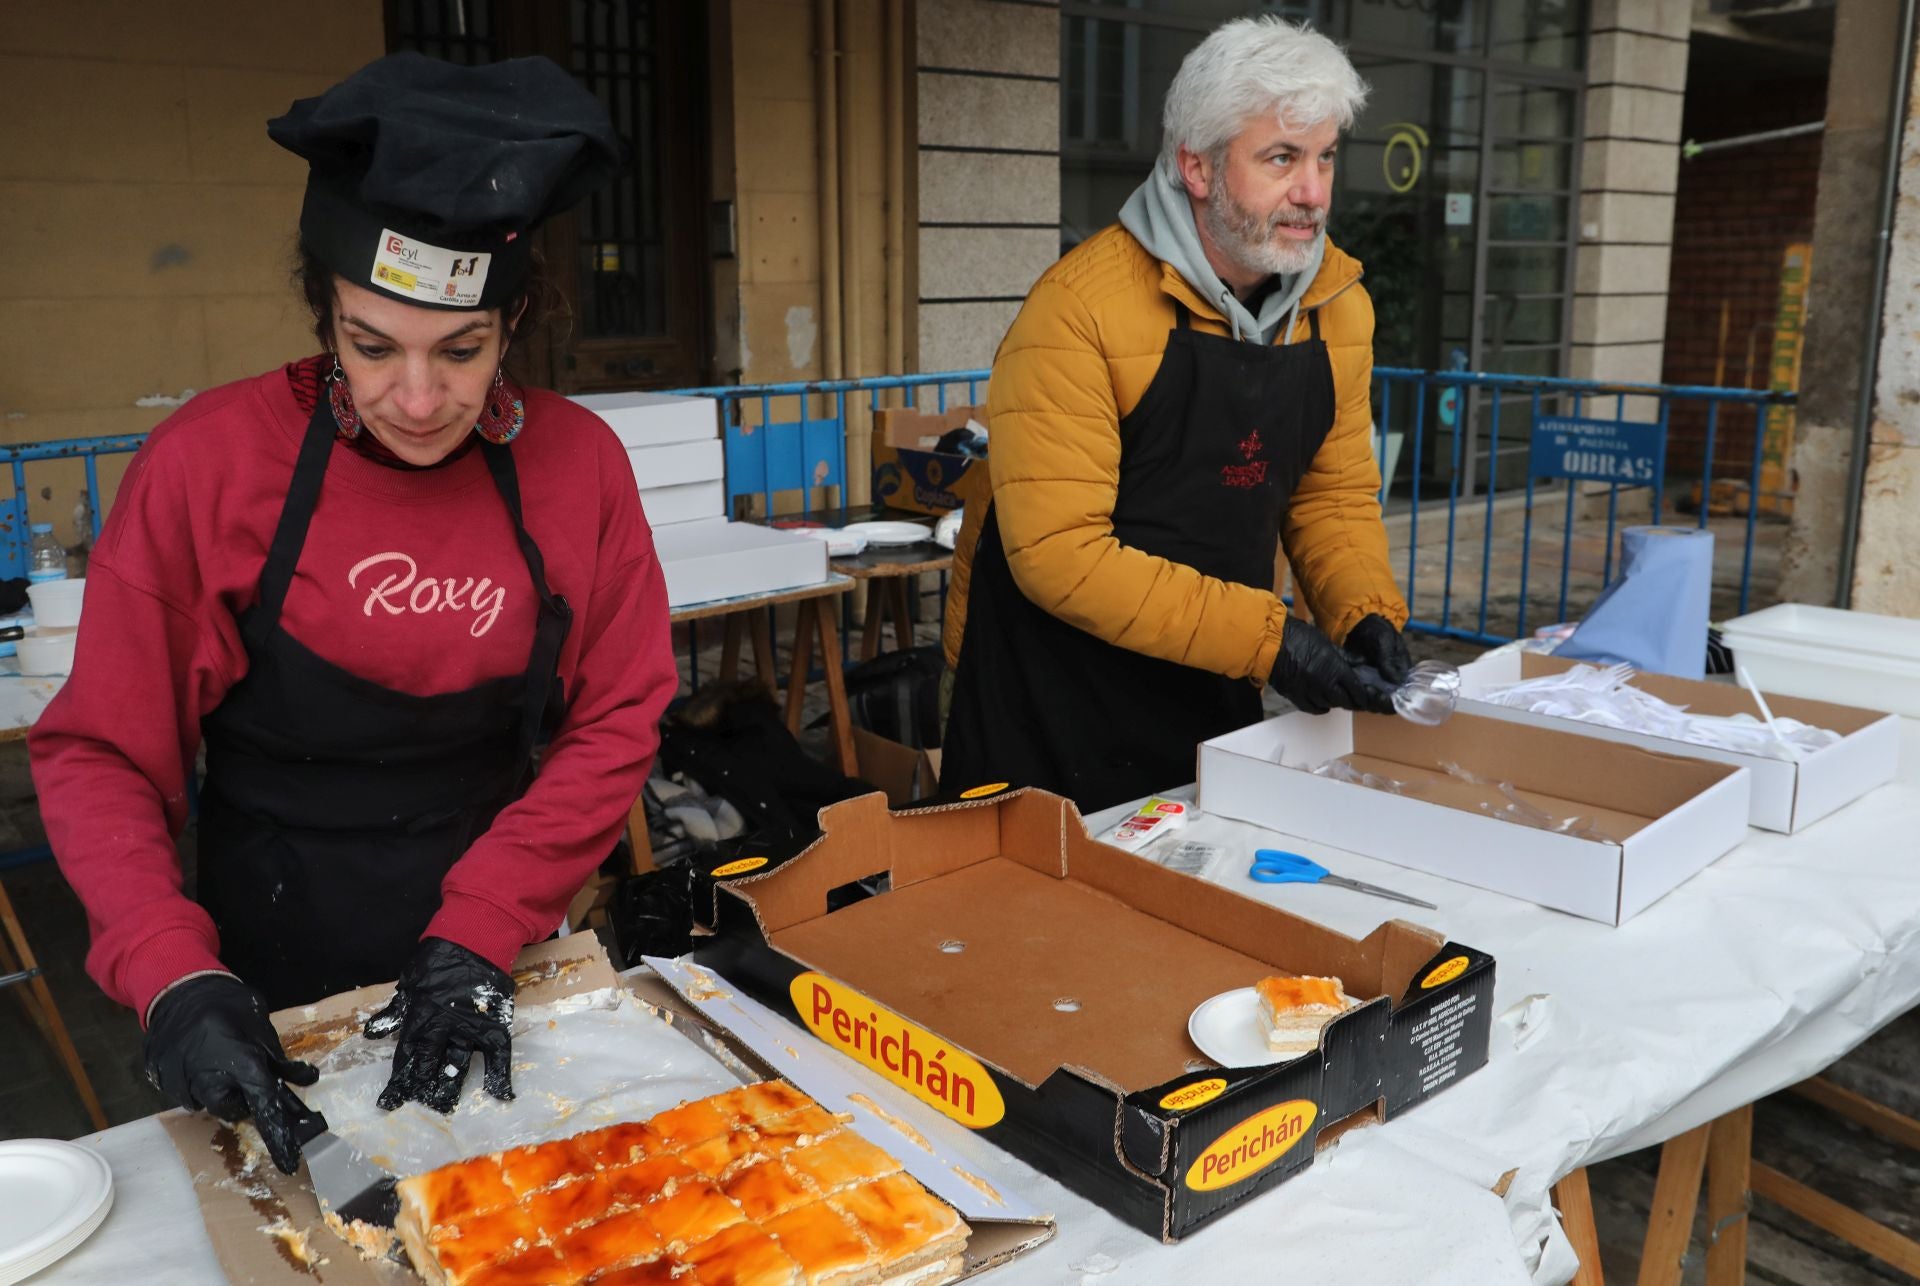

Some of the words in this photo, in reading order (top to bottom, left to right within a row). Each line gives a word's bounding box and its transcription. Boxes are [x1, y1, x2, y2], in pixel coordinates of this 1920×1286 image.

[1563, 450, 1653, 480] OBRAS
[348, 551, 506, 638] Roxy
[813, 982, 975, 1117] Perichán
[1165, 1081, 1221, 1106] Perichán
[1202, 1113, 1302, 1184] Perichán
